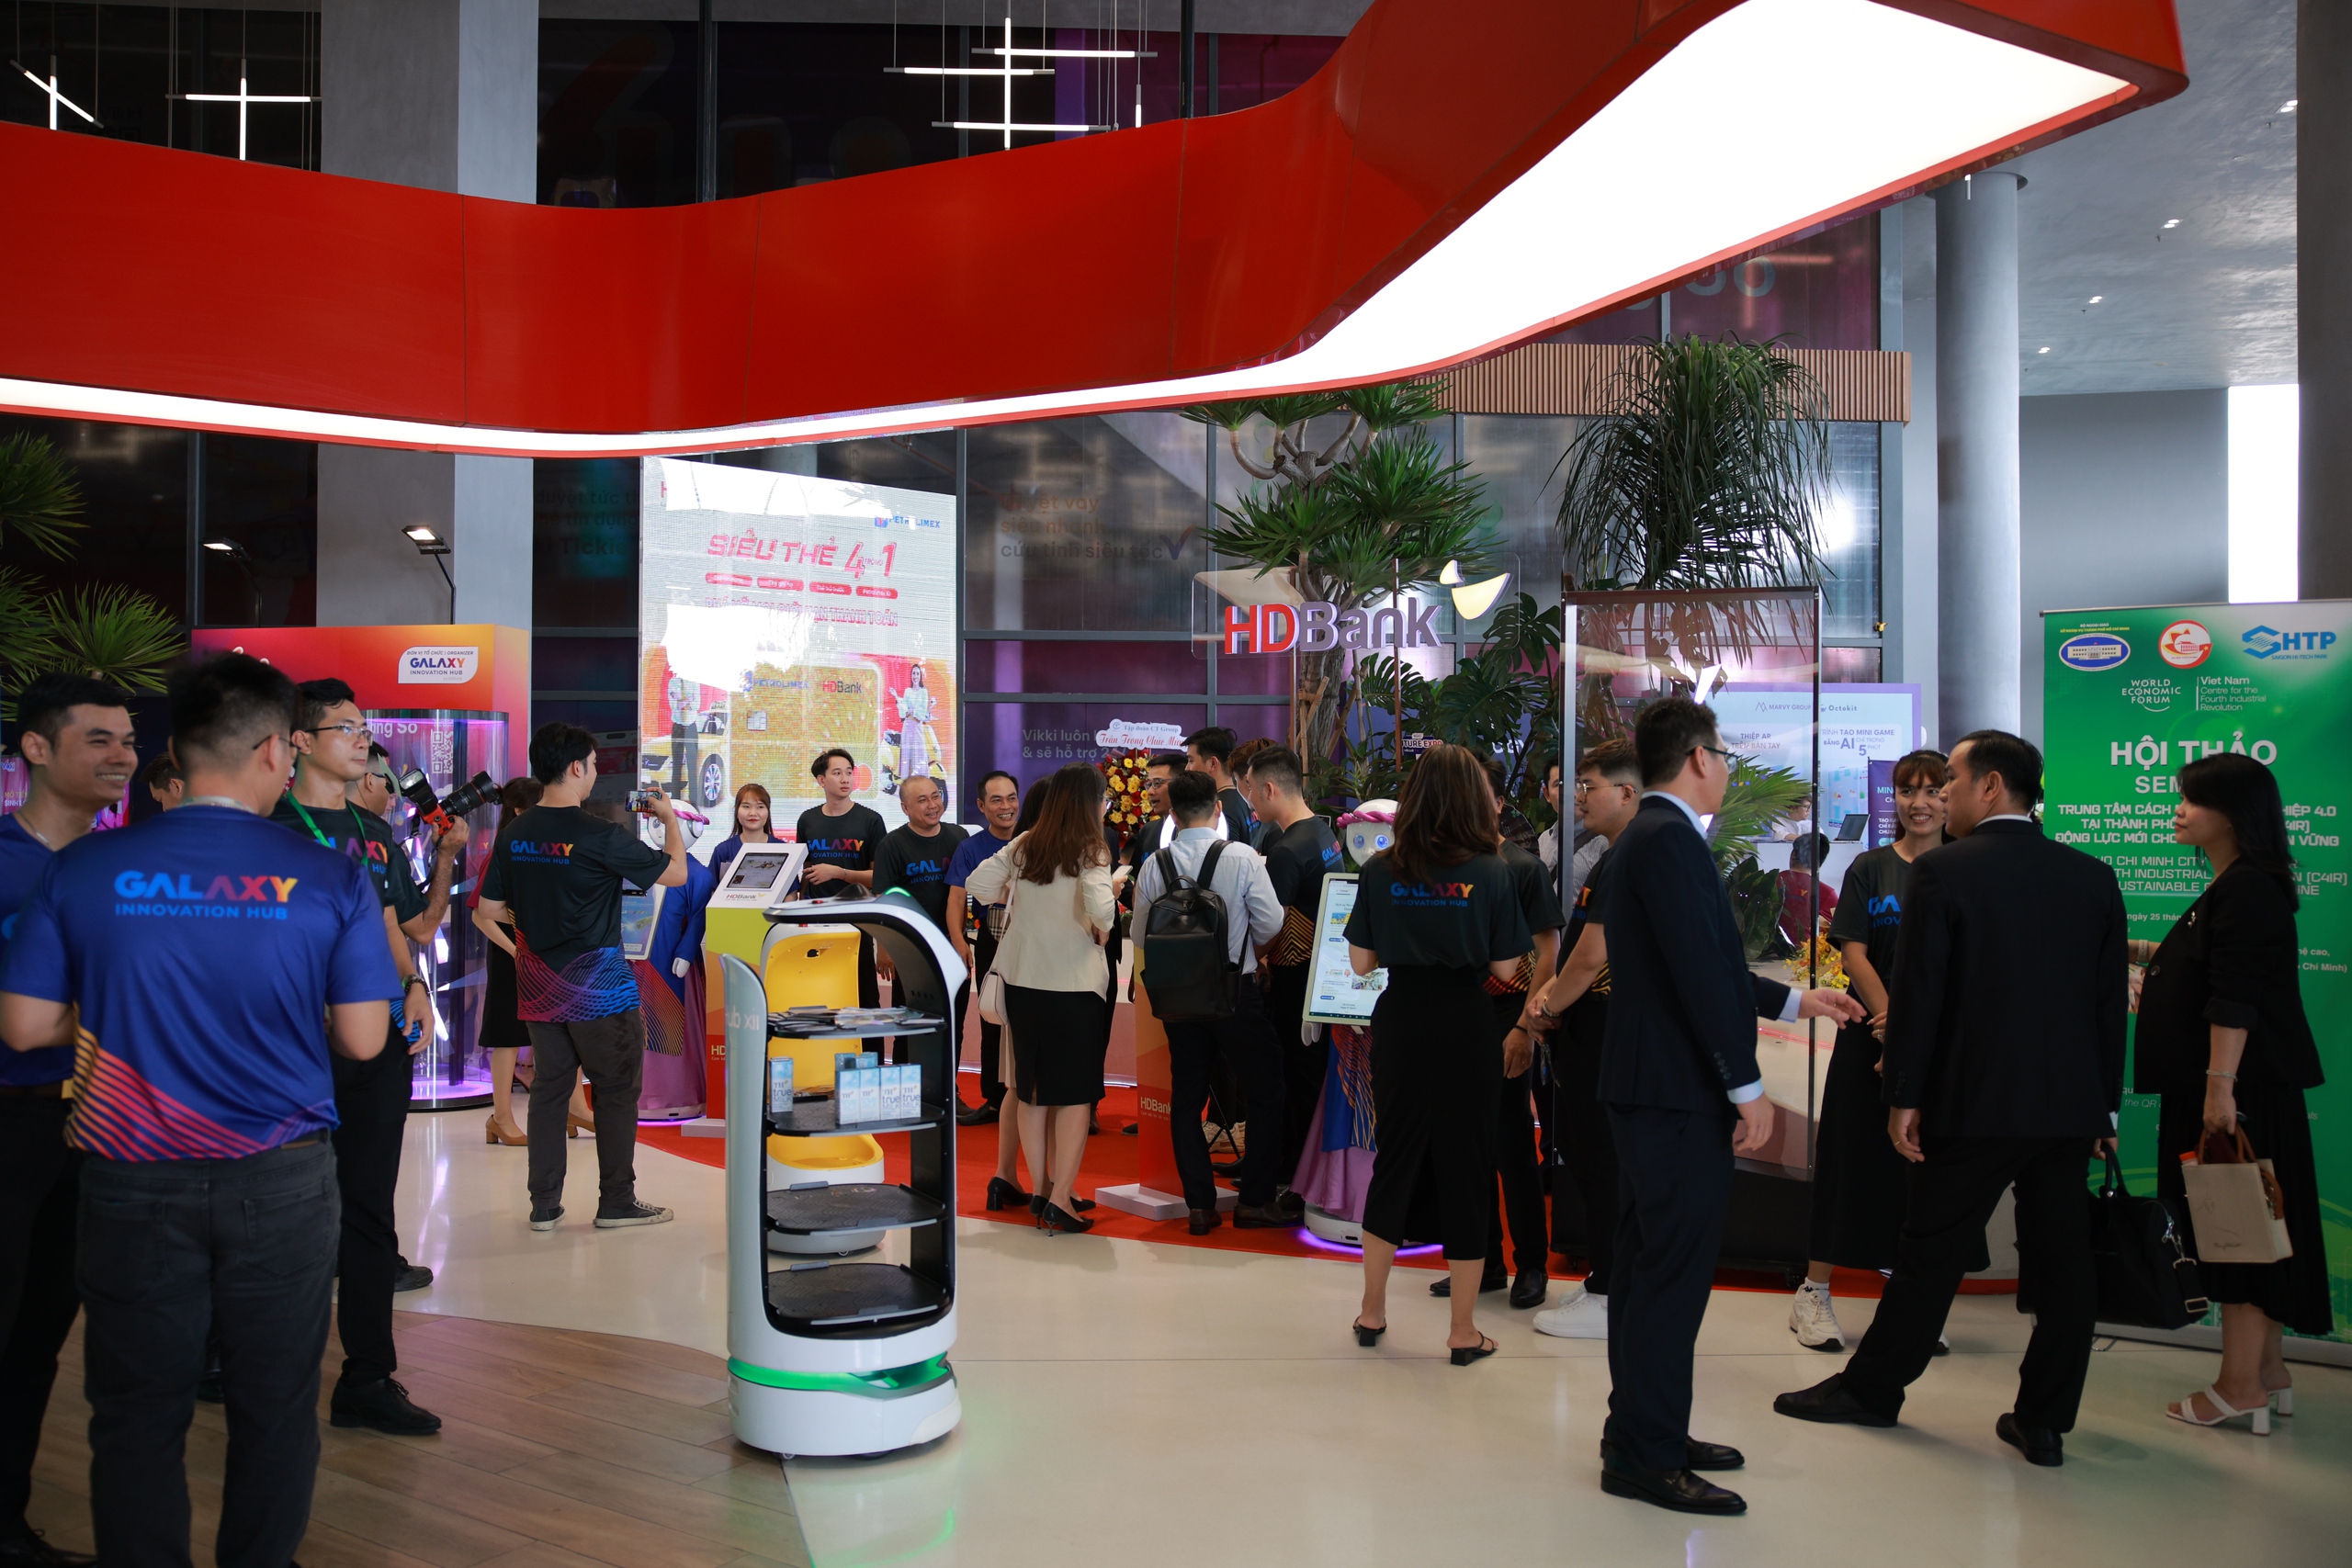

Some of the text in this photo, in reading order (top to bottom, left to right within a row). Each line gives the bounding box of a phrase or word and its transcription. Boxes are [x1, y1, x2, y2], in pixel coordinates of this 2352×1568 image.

[844, 541, 865, 579] 4
[882, 542, 897, 578] 1
[1224, 597, 1442, 654] HDBank
[410, 657, 466, 668] GALAXY
[2131, 678, 2170, 687] WORLD
[2200, 676, 2250, 685] Viet Nam
[822, 680, 862, 693] HDBank
[2121, 686, 2181, 695] ECONOMIC
[2200, 686, 2228, 694] Centre
[2131, 695, 2170, 704] FORUM
[2200, 694, 2266, 703] Fourth Industrial
[2200, 703, 2243, 711] Revolution
[1023, 728, 1090, 741] Vikki luôn
[1840, 738, 1855, 750] AI
[1859, 745, 1867, 756] 5
[2110, 735, 2167, 771] HỘI
[2058, 804, 2101, 815] TRUNG
[2104, 802, 2132, 815] TÂM
[2134, 802, 2171, 815] CÁCH
[2314, 806, 2336, 817] 4.0
[2081, 818, 2100, 830] TẠI
[2103, 816, 2148, 829] THÀNH
[2055, 830, 2090, 844] ĐỘNG
[2094, 832, 2120, 844] LỰC
[2124, 830, 2148, 843] MỚI
[2299, 833, 2339, 846] VỮNG
[510, 840, 574, 856] GALAXY
[907, 856, 951, 875] GALA
[2116, 856, 2138, 865] CHI
[2142, 856, 2174, 866] MINH
[911, 874, 944, 884] INNOVAT
[2134, 868, 2212, 879] INDUSTRIAL
[114, 870, 299, 903] GALAXY
[1390, 882, 1474, 898] GALAXY
[2118, 881, 2199, 891] USTAINABLE
[1449, 899, 1468, 908] HUB
[115, 904, 288, 919] INNOVATION HUB
[2127, 912, 2148, 922] ngày
[882, 1095, 899, 1103] true
[902, 1093, 920, 1102] true
[2124, 1099, 2157, 1108] the QR
